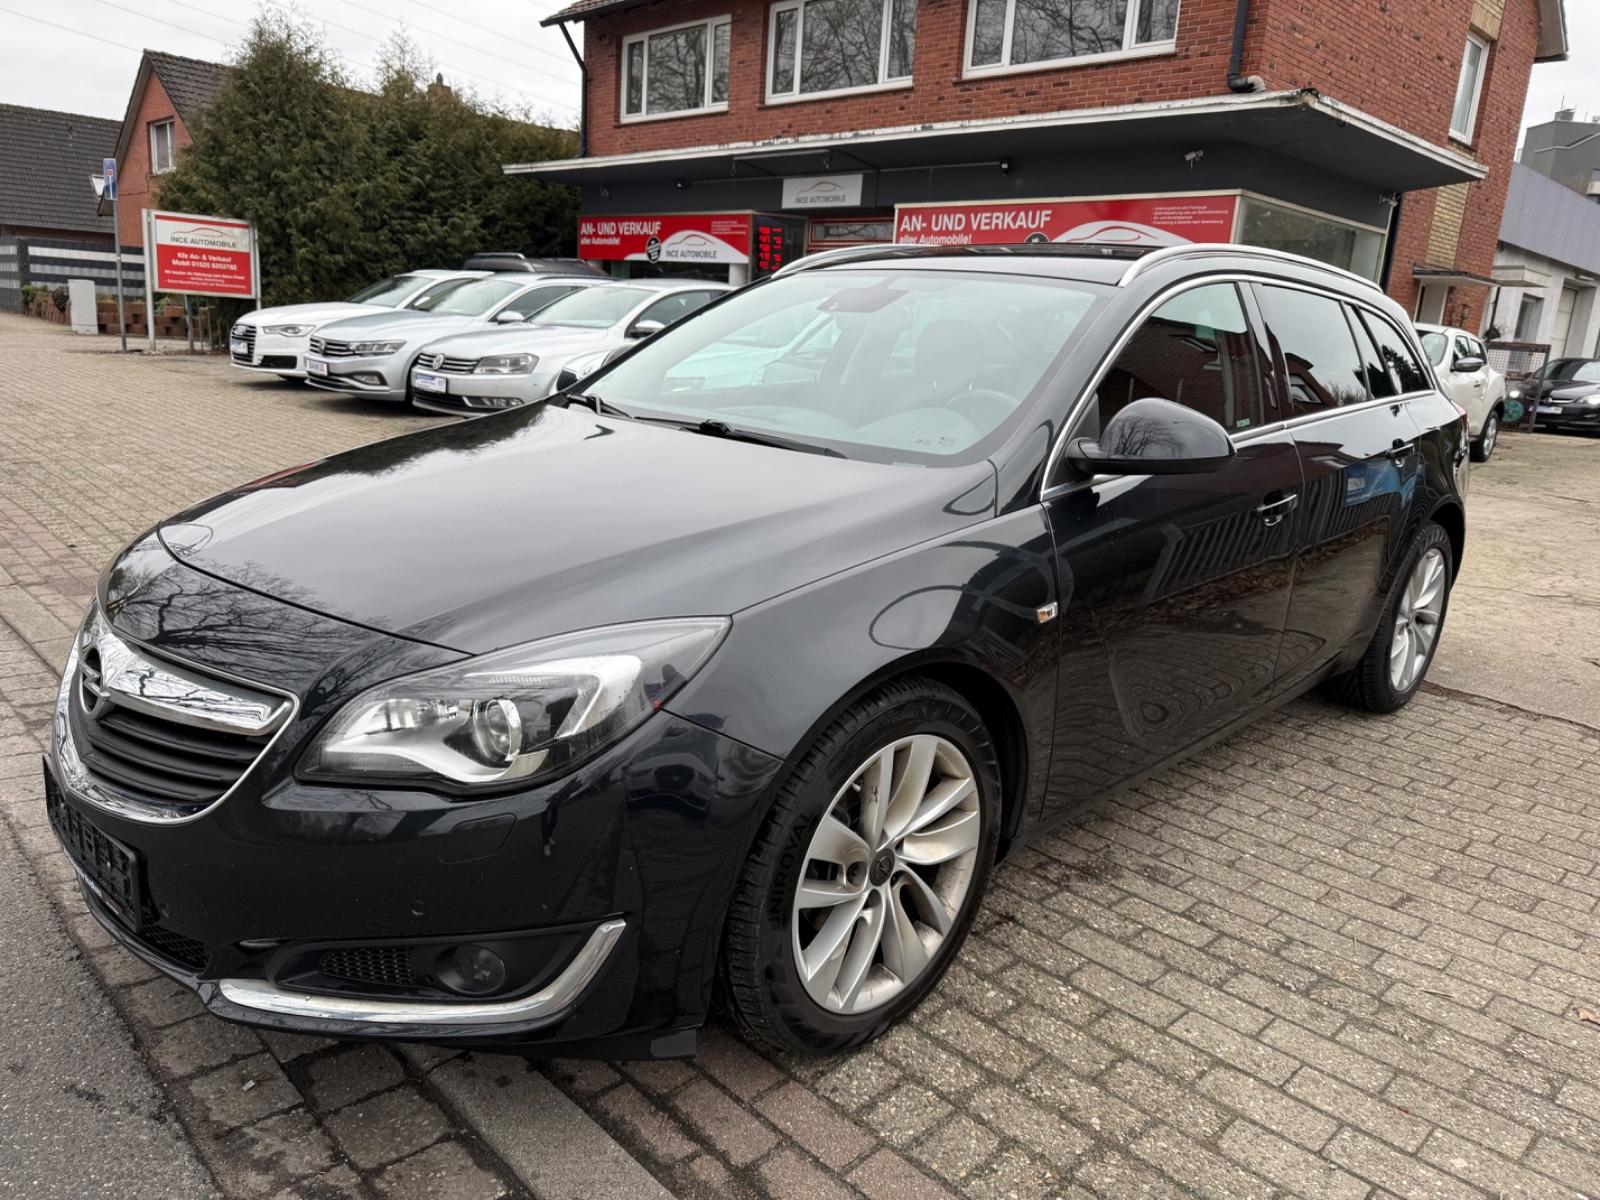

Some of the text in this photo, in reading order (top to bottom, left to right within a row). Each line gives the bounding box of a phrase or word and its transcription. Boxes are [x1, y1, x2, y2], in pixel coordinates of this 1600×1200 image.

[809, 194, 846, 203] AUTOMOBILE
[900, 210, 1052, 232] AN- UND VERKAUF
[581, 221, 661, 235] AN- UND VERKAUF
[190, 239, 237, 248] AUTOMOBILE
[900, 234, 972, 245] aller Automobile!
[680, 250, 717, 258] AUTOMOBILE
[208, 255, 232, 263] Verkauf
